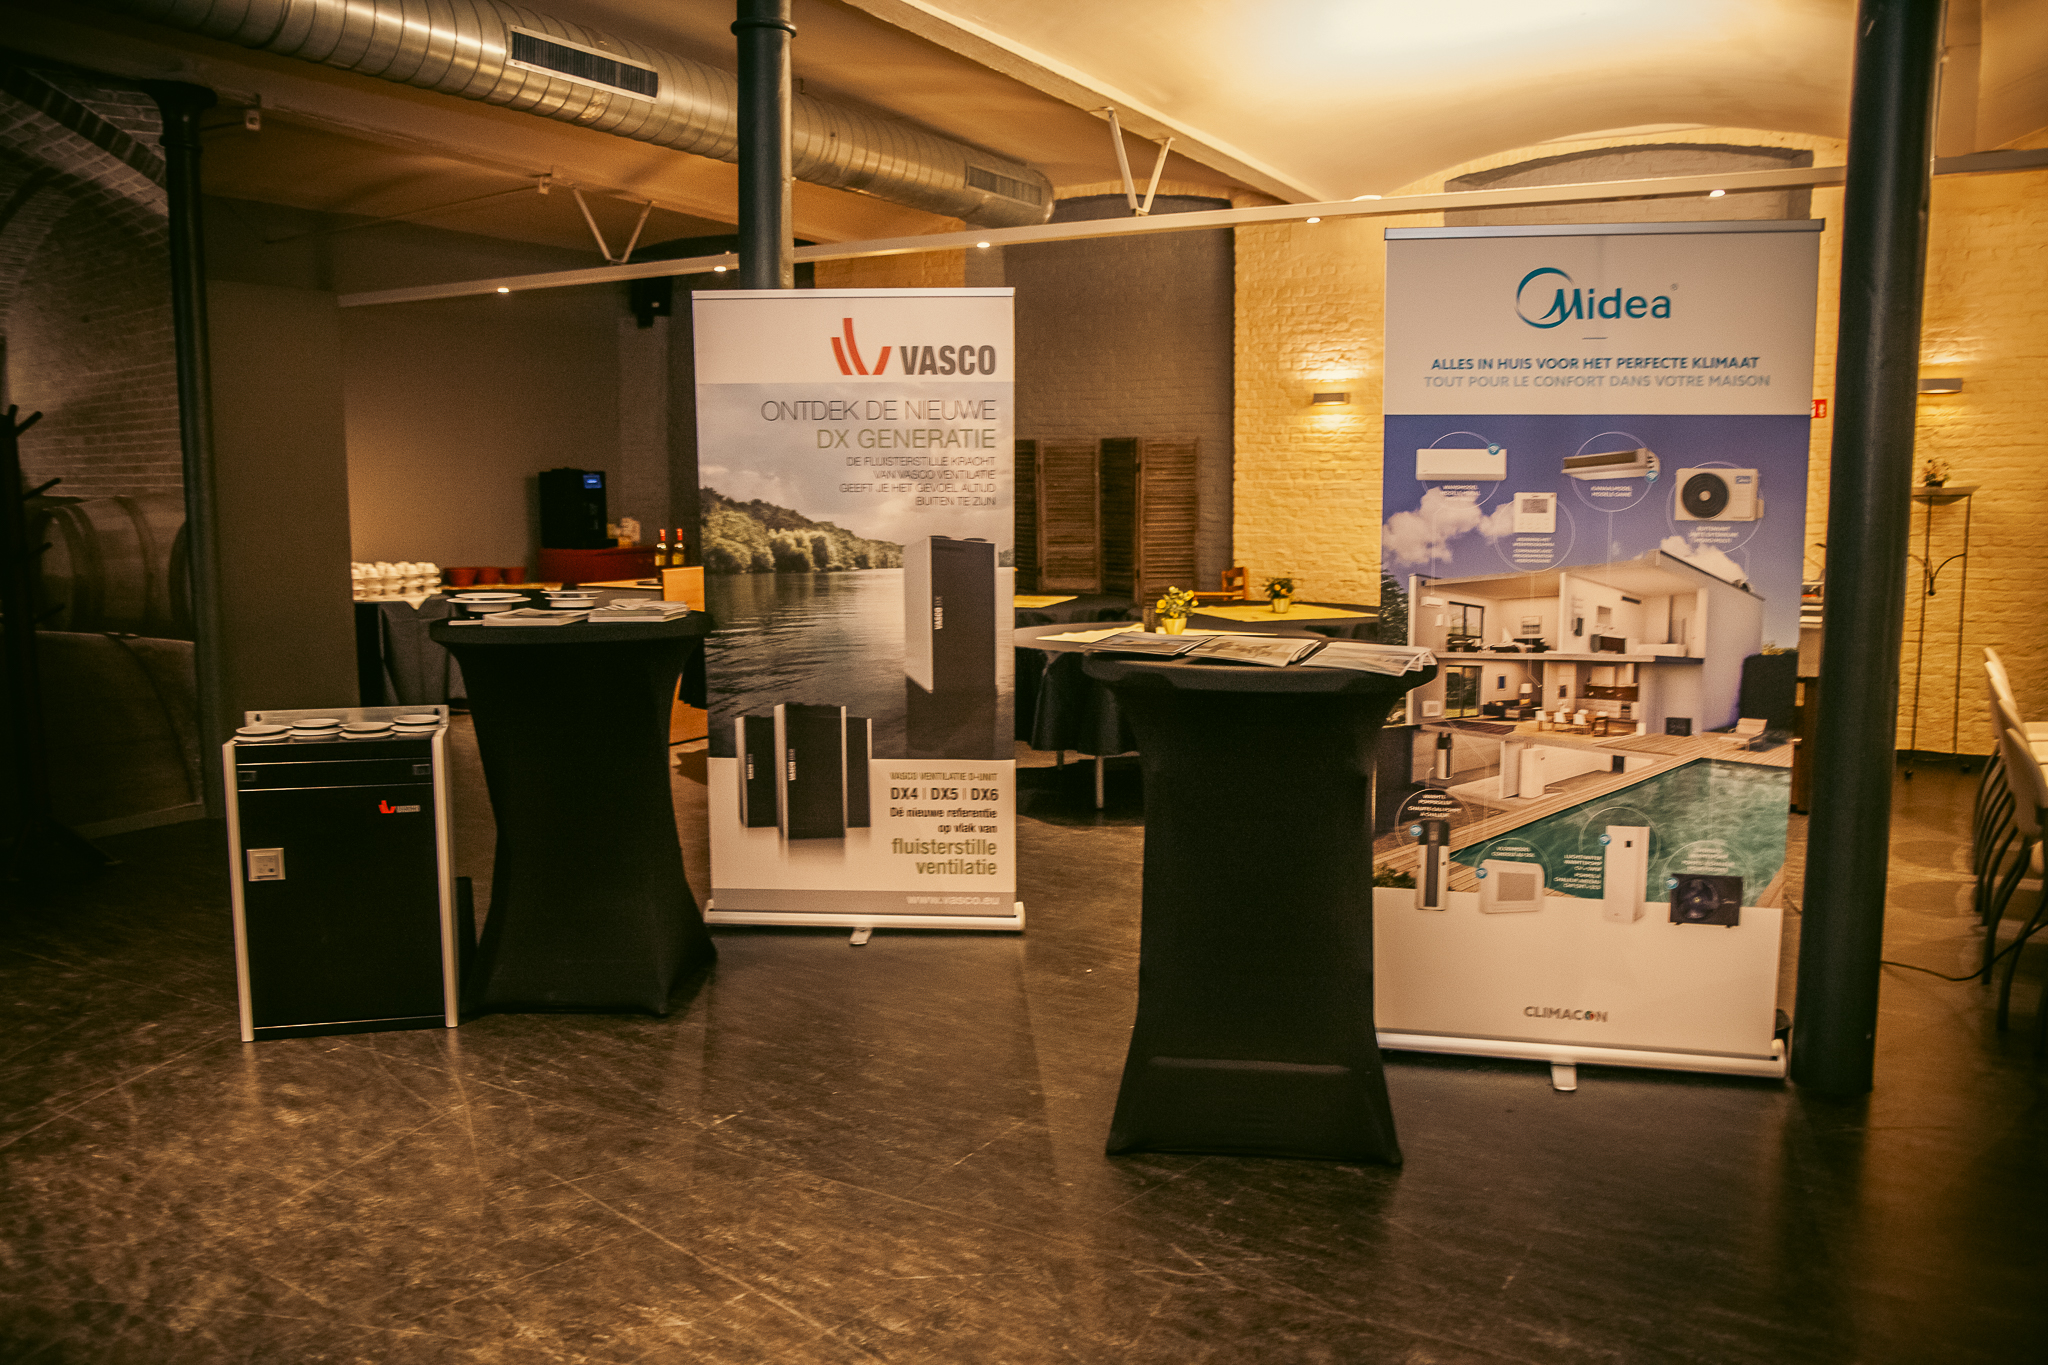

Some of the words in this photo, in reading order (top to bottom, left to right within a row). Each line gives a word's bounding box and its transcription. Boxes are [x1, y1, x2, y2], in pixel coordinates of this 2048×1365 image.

[899, 345, 996, 376] VASCO
[1431, 358, 1474, 370] ALLES
[1478, 358, 1493, 370] IN
[1497, 358, 1532, 370] HUIS
[1536, 358, 1579, 370] VOOR
[1582, 358, 1612, 369] HET
[1616, 357, 1688, 369] PERFECTE
[1692, 357, 1760, 369] KLIMAAT
[1424, 376, 1464, 387] TOUT
[1468, 376, 1510, 387] POUR
[1514, 376, 1529, 387] LE
[1534, 376, 1605, 387] CONFORT
[1610, 376, 1650, 386] DANS
[1654, 376, 1704, 386] VOTRE
[1708, 375, 1771, 386] MAISON
[761, 400, 860, 421] ONTDEK
[866, 400, 897, 420] DE
[905, 400, 996, 420] NIEUWE
[817, 429, 849, 449] DX
[857, 428, 996, 449] GENERATIE
[846, 456, 860, 467] DE
[863, 456, 948, 467] FLUISTERSTILLE
[950, 456, 996, 467] KRACHT
[873, 469, 895, 480] VAN
[897, 469, 936, 480] VASCO
[936, 469, 996, 480] VENTILATIE
[840, 482, 873, 493] GEEFT
[875, 482, 889, 493] JE
[892, 482, 912, 493] HET
[915, 482, 958, 493] GEVOEL
[960, 482, 996, 493] ALTIJD
[915, 496, 954, 506] BUITEN
[956, 496, 971, 506] TE
[972, 496, 997, 506] ZIJN
[933, 607, 943, 630] VASCO
[890, 772, 918, 780] VASCO
[920, 772, 966, 780] VENTILATIE
[890, 787, 918, 800] DX4
[930, 788, 959, 800] DX5
[970, 788, 999, 801] DX6
[906, 808, 944, 818] nieuwe
[946, 808, 998, 818] referentie
[938, 824, 952, 834] op
[953, 823, 976, 833] vlak
[978, 825, 998, 833] van
[892, 838, 997, 855] fluisterstille
[916, 859, 997, 875] ventilatie
[906, 896, 1000, 905] www.vasco.eu
[1523, 1006, 1609, 1022] CLIMACON
